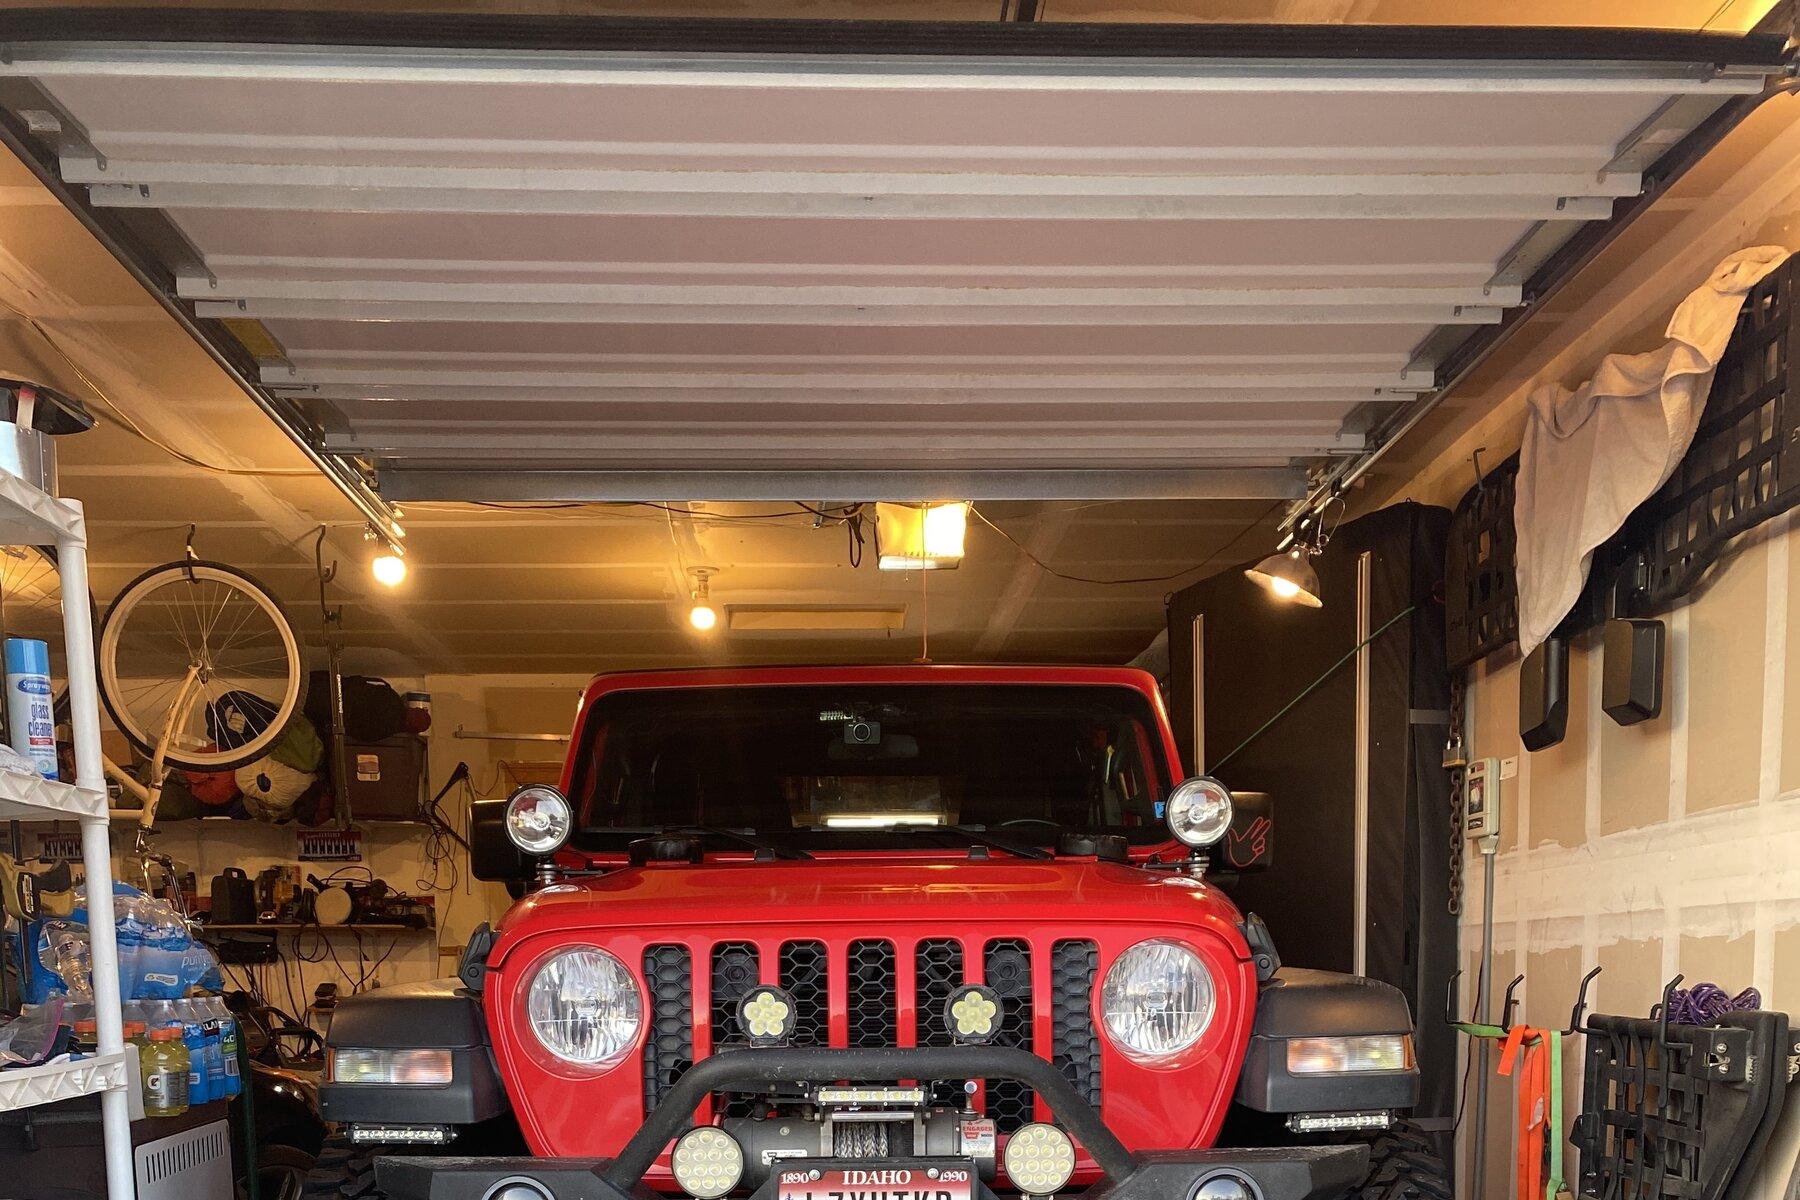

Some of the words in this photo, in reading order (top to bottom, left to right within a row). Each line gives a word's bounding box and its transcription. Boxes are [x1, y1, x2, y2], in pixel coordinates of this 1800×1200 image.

[31, 702, 50, 720] glass
[28, 721, 53, 737] cleaner
[781, 1173, 809, 1184] 1890
[842, 1170, 912, 1185] IDAHO
[938, 1171, 968, 1183] 1990
